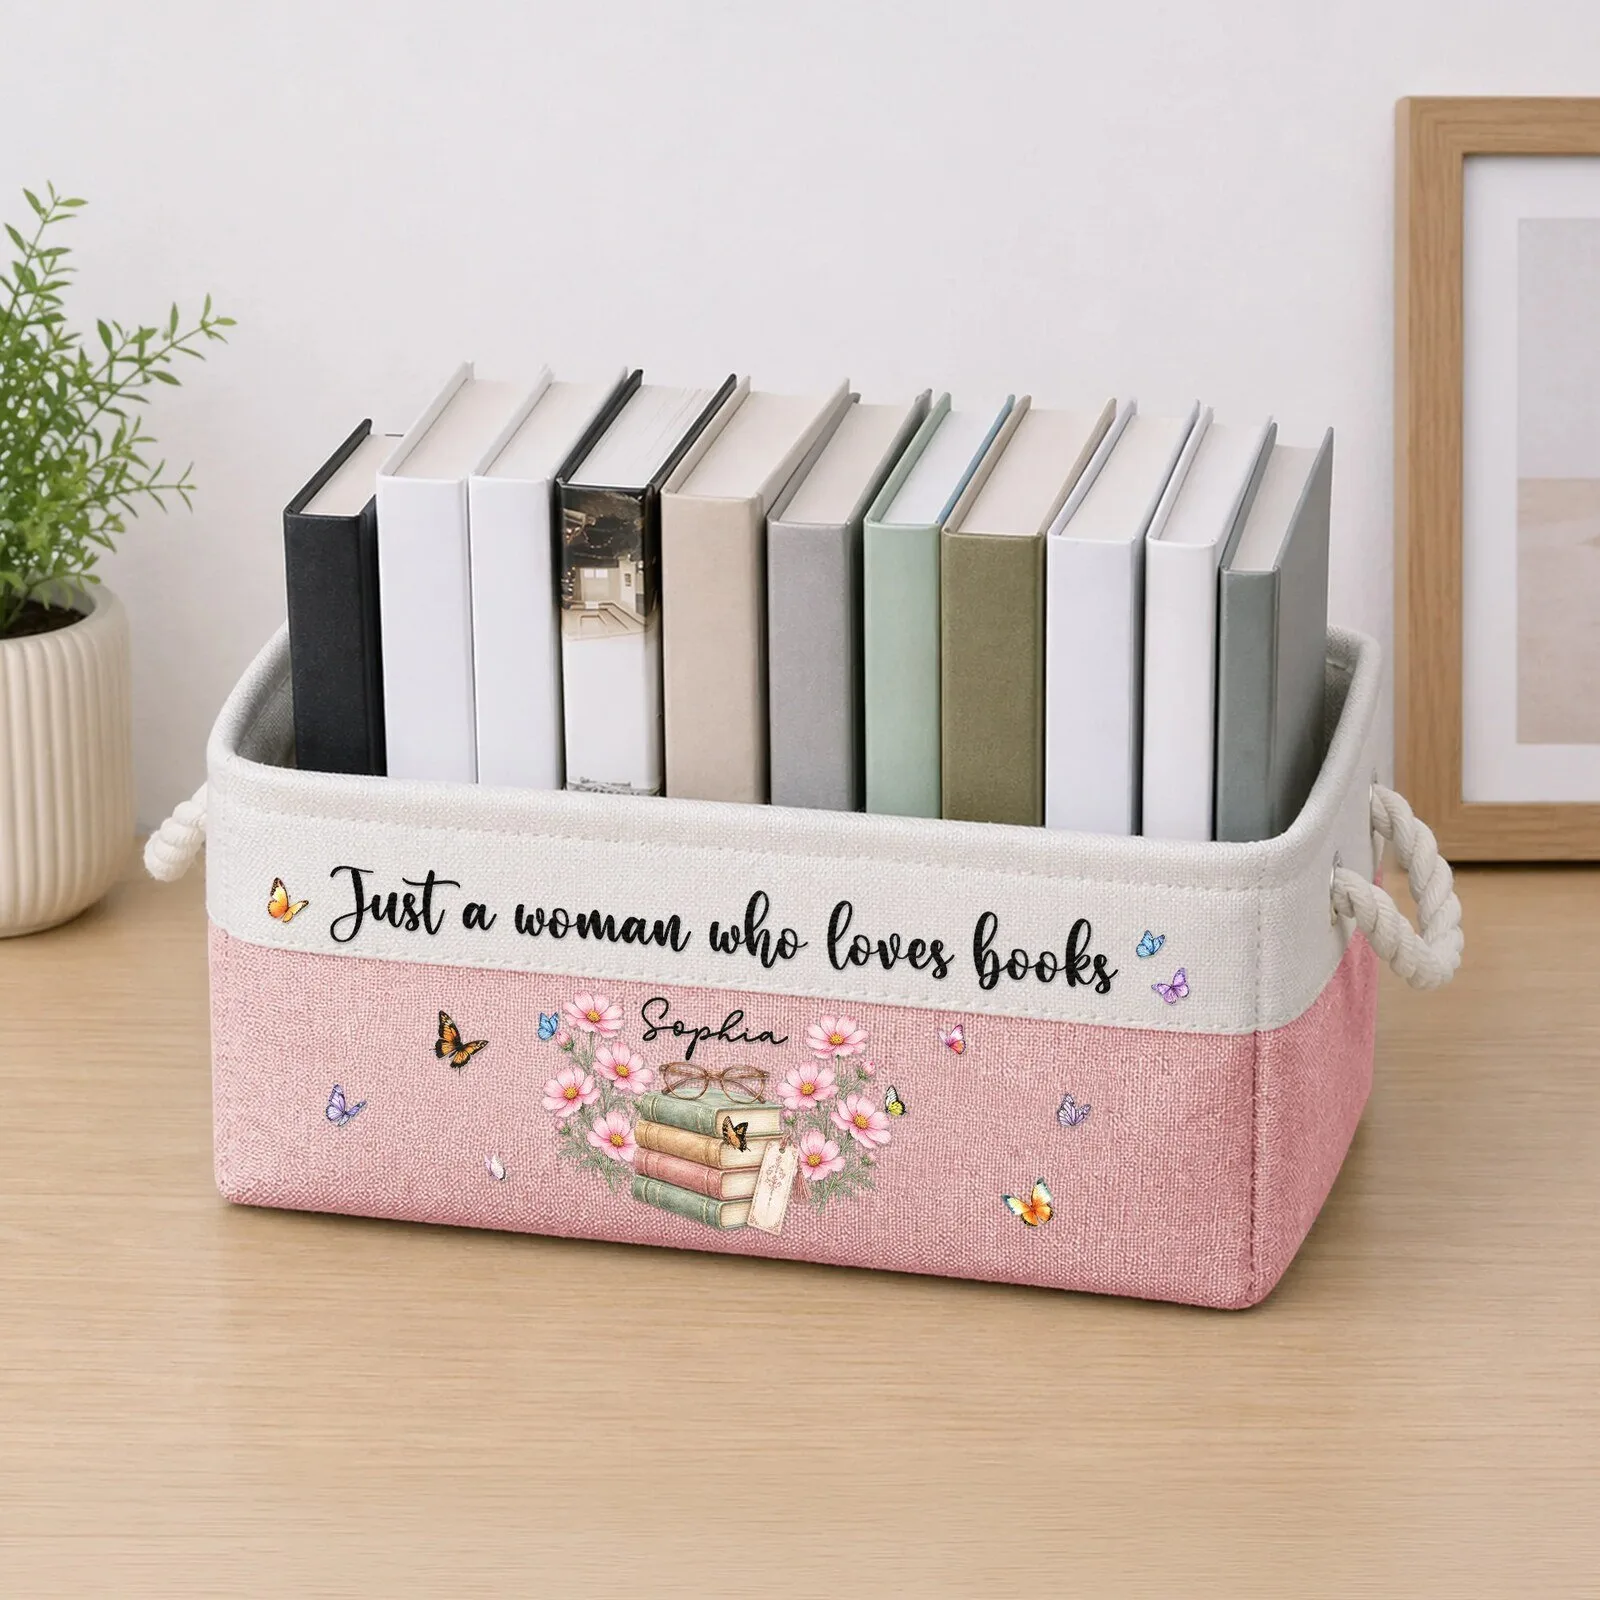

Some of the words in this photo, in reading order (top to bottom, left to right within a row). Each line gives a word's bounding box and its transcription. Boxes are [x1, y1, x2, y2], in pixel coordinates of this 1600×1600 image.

[329, 865, 461, 943] Just
[462, 902, 498, 931] a
[514, 903, 692, 953] woman
[709, 890, 809, 969] who
[826, 900, 955, 980] loves
[972, 911, 1119, 995] books
[640, 996, 790, 1061] Sophia
